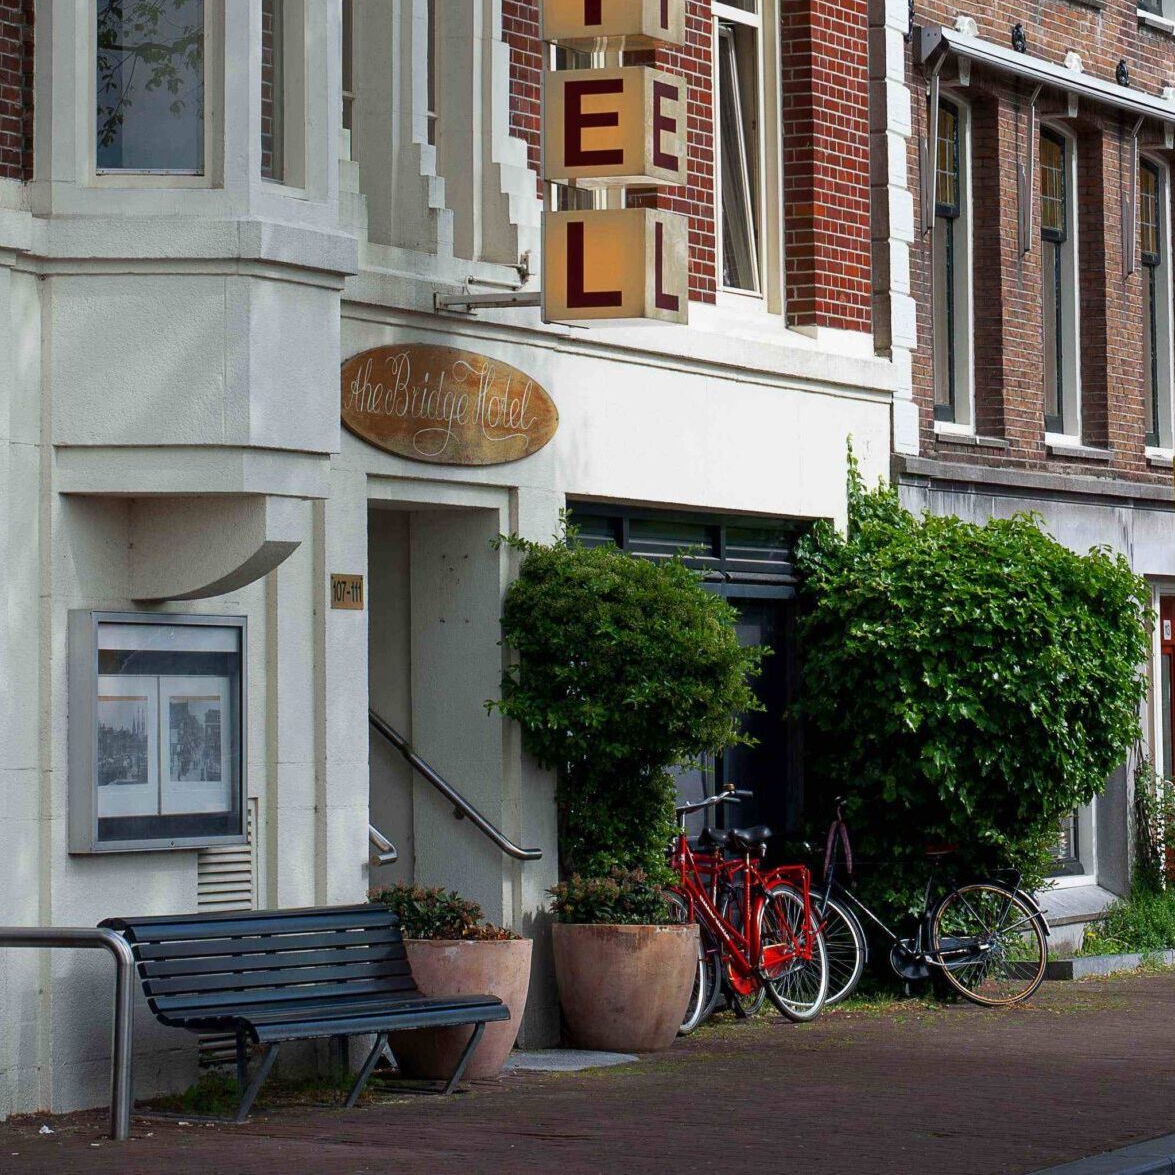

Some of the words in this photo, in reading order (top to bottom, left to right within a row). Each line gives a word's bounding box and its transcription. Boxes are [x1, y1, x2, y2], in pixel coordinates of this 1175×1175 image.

[385, 351, 470, 456] Bridge
[453, 360, 537, 450] Hotel
[333, 581, 362, 603] 107-111
